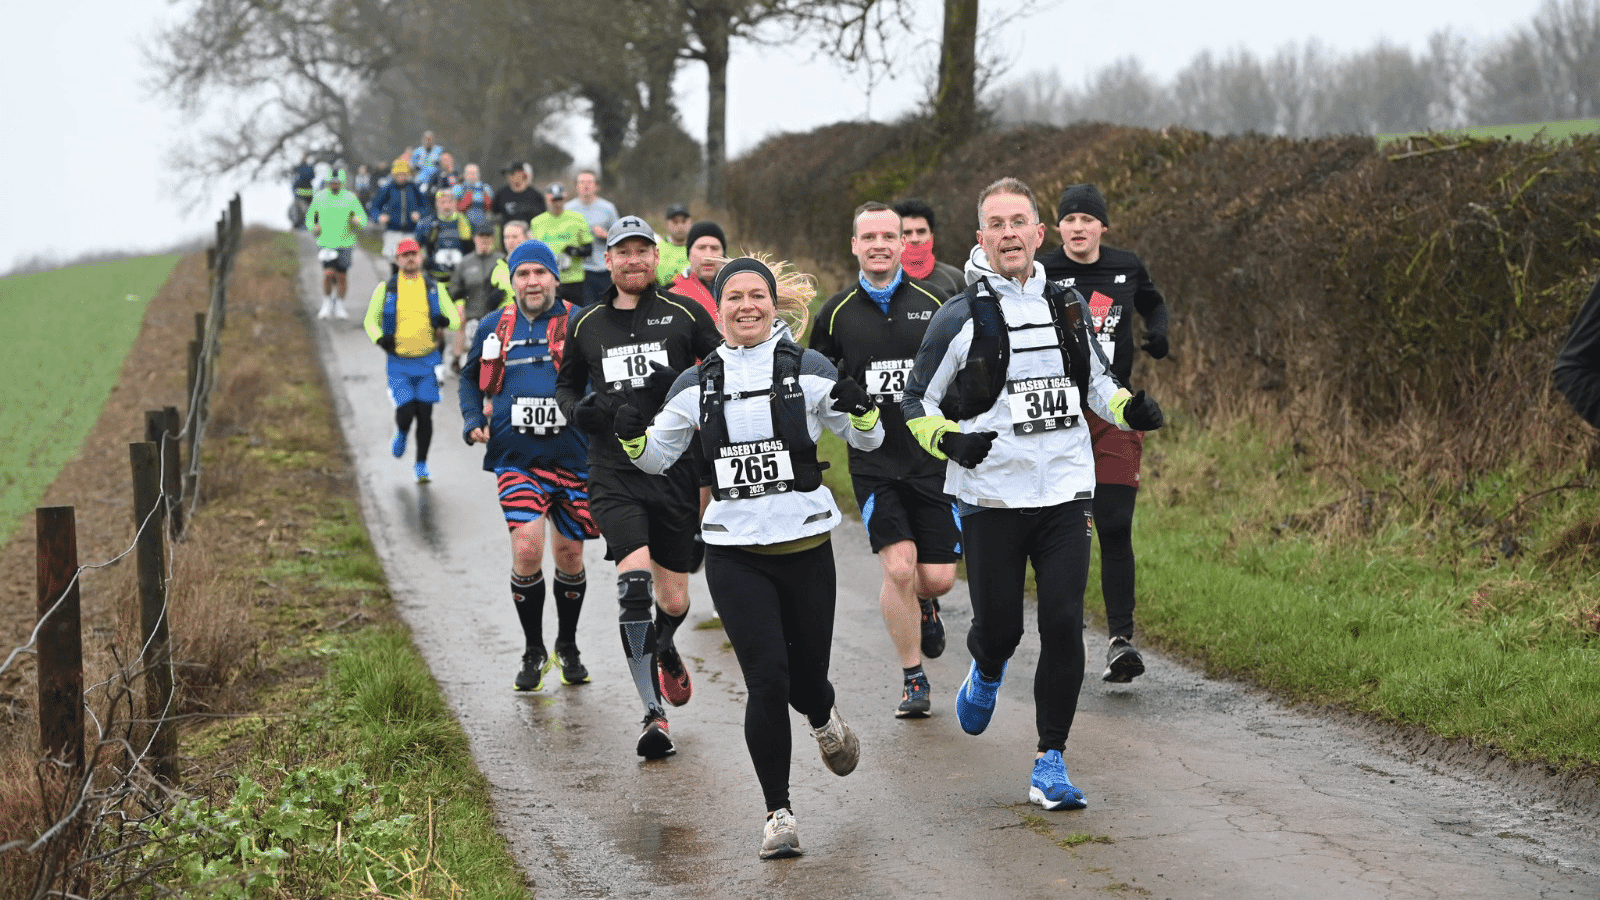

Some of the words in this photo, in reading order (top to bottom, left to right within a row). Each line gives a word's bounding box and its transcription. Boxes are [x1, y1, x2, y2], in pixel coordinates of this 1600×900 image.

[1105, 316, 1120, 327] OF
[607, 345, 638, 358] NASEBY
[640, 342, 661, 353] 1645
[623, 355, 647, 377] 18
[871, 360, 902, 370] NASEBY
[903, 359, 914, 368] 16
[879, 370, 905, 392] 23
[1013, 379, 1049, 393] NASEBY
[1050, 377, 1071, 388] 1645
[1025, 390, 1068, 419] 344
[523, 407, 557, 425] 304
[720, 443, 756, 457] NASEBY
[758, 440, 783, 453] 1645
[730, 453, 779, 485] 265
[749, 484, 765, 494] 2025
